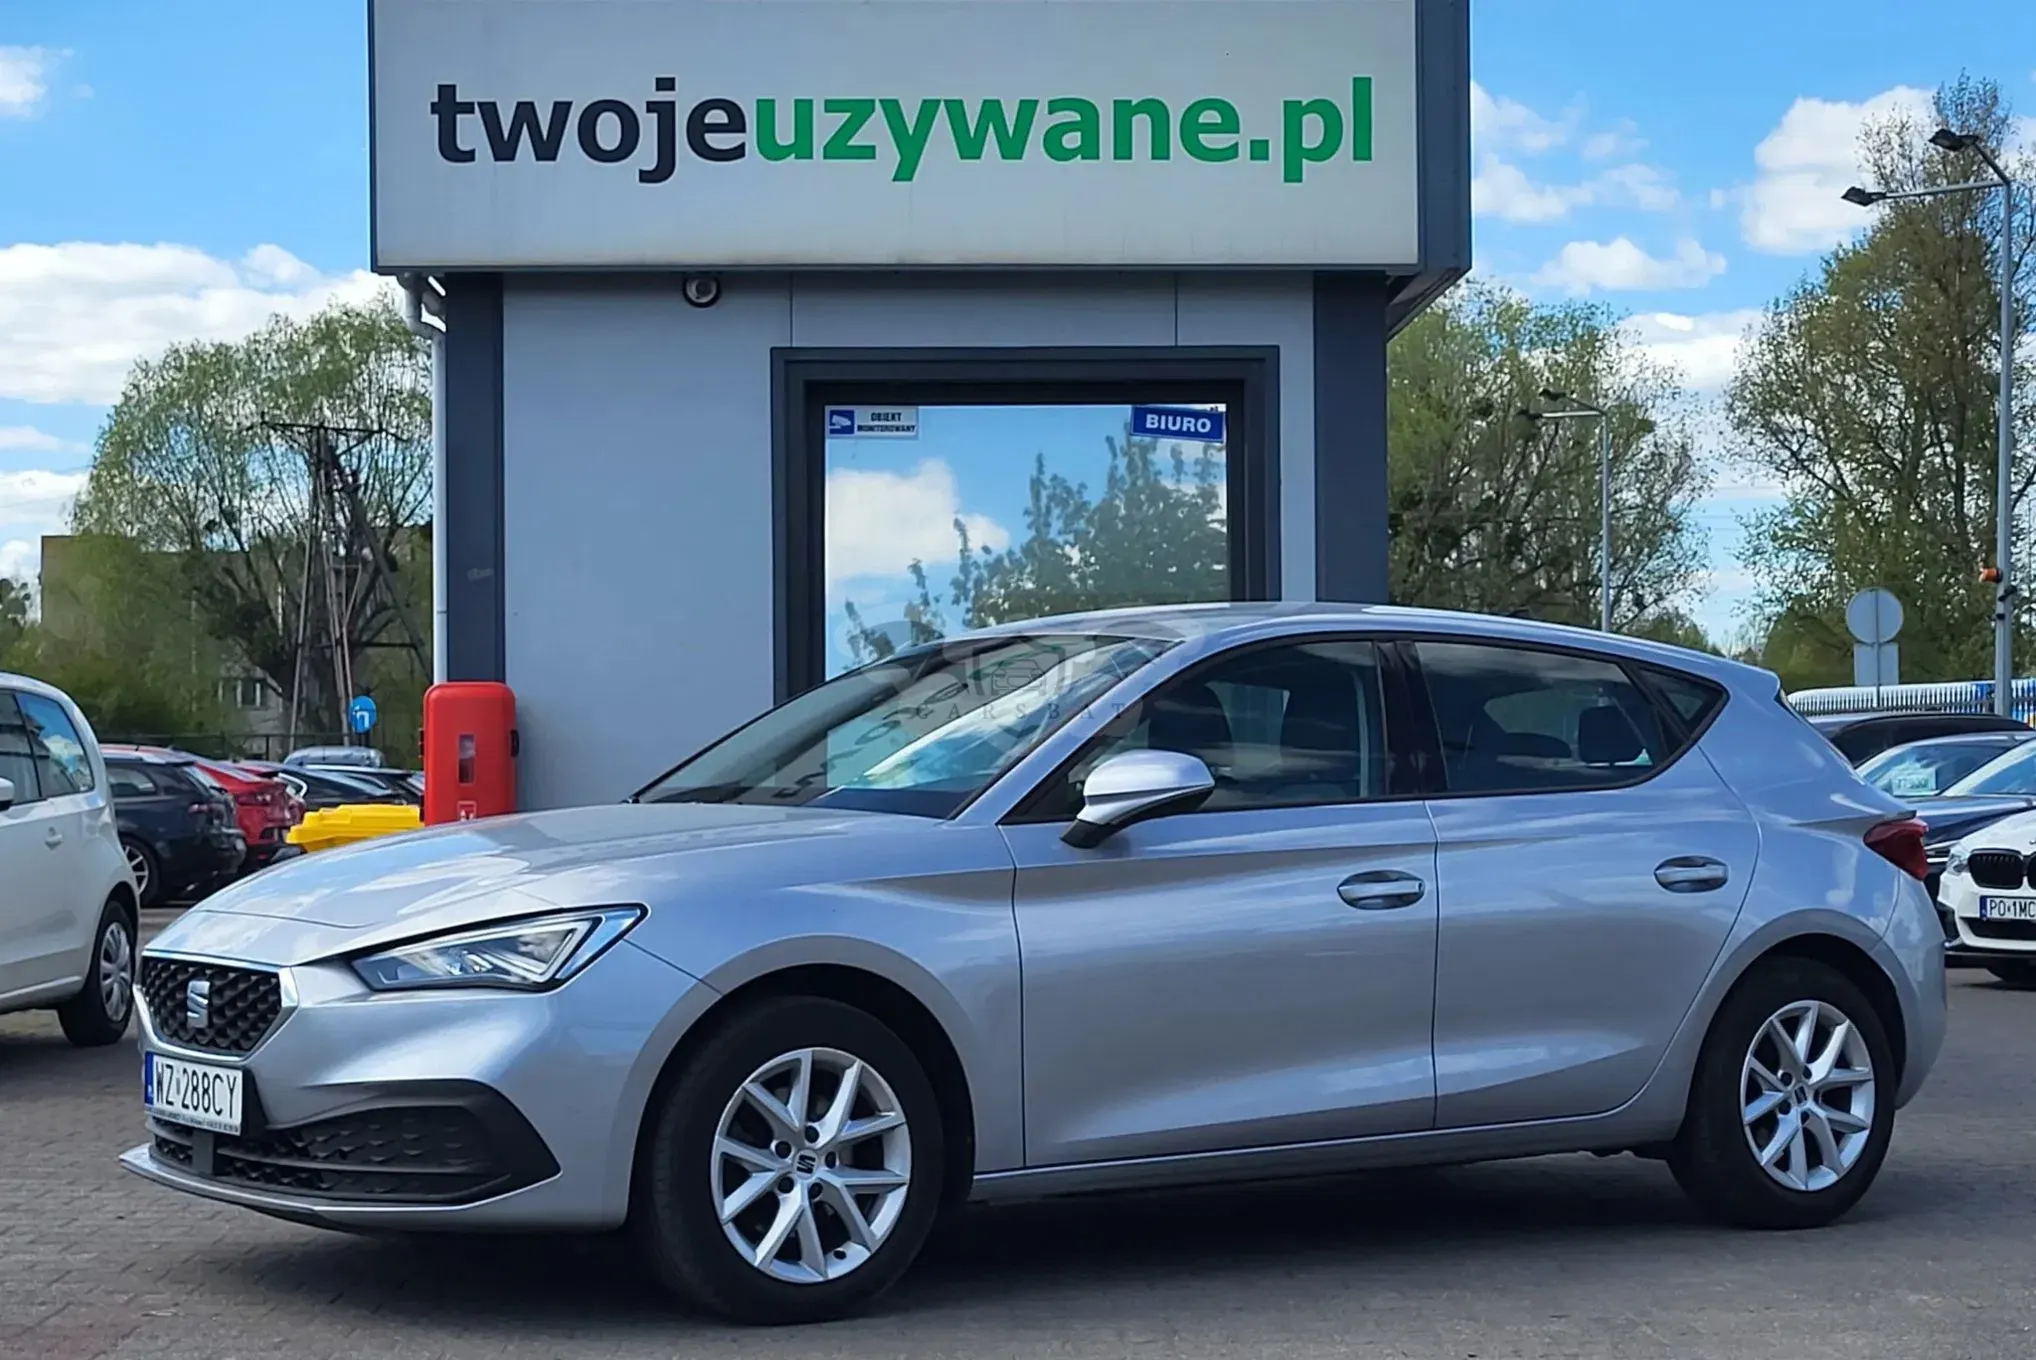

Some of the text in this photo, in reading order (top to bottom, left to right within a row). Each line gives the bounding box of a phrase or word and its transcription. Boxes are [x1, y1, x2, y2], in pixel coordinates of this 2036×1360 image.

[430, 77, 1372, 183] twojeuzywane.pl
[1145, 413, 1212, 433] BIURO
[181, 1067, 237, 1120] 288CY
